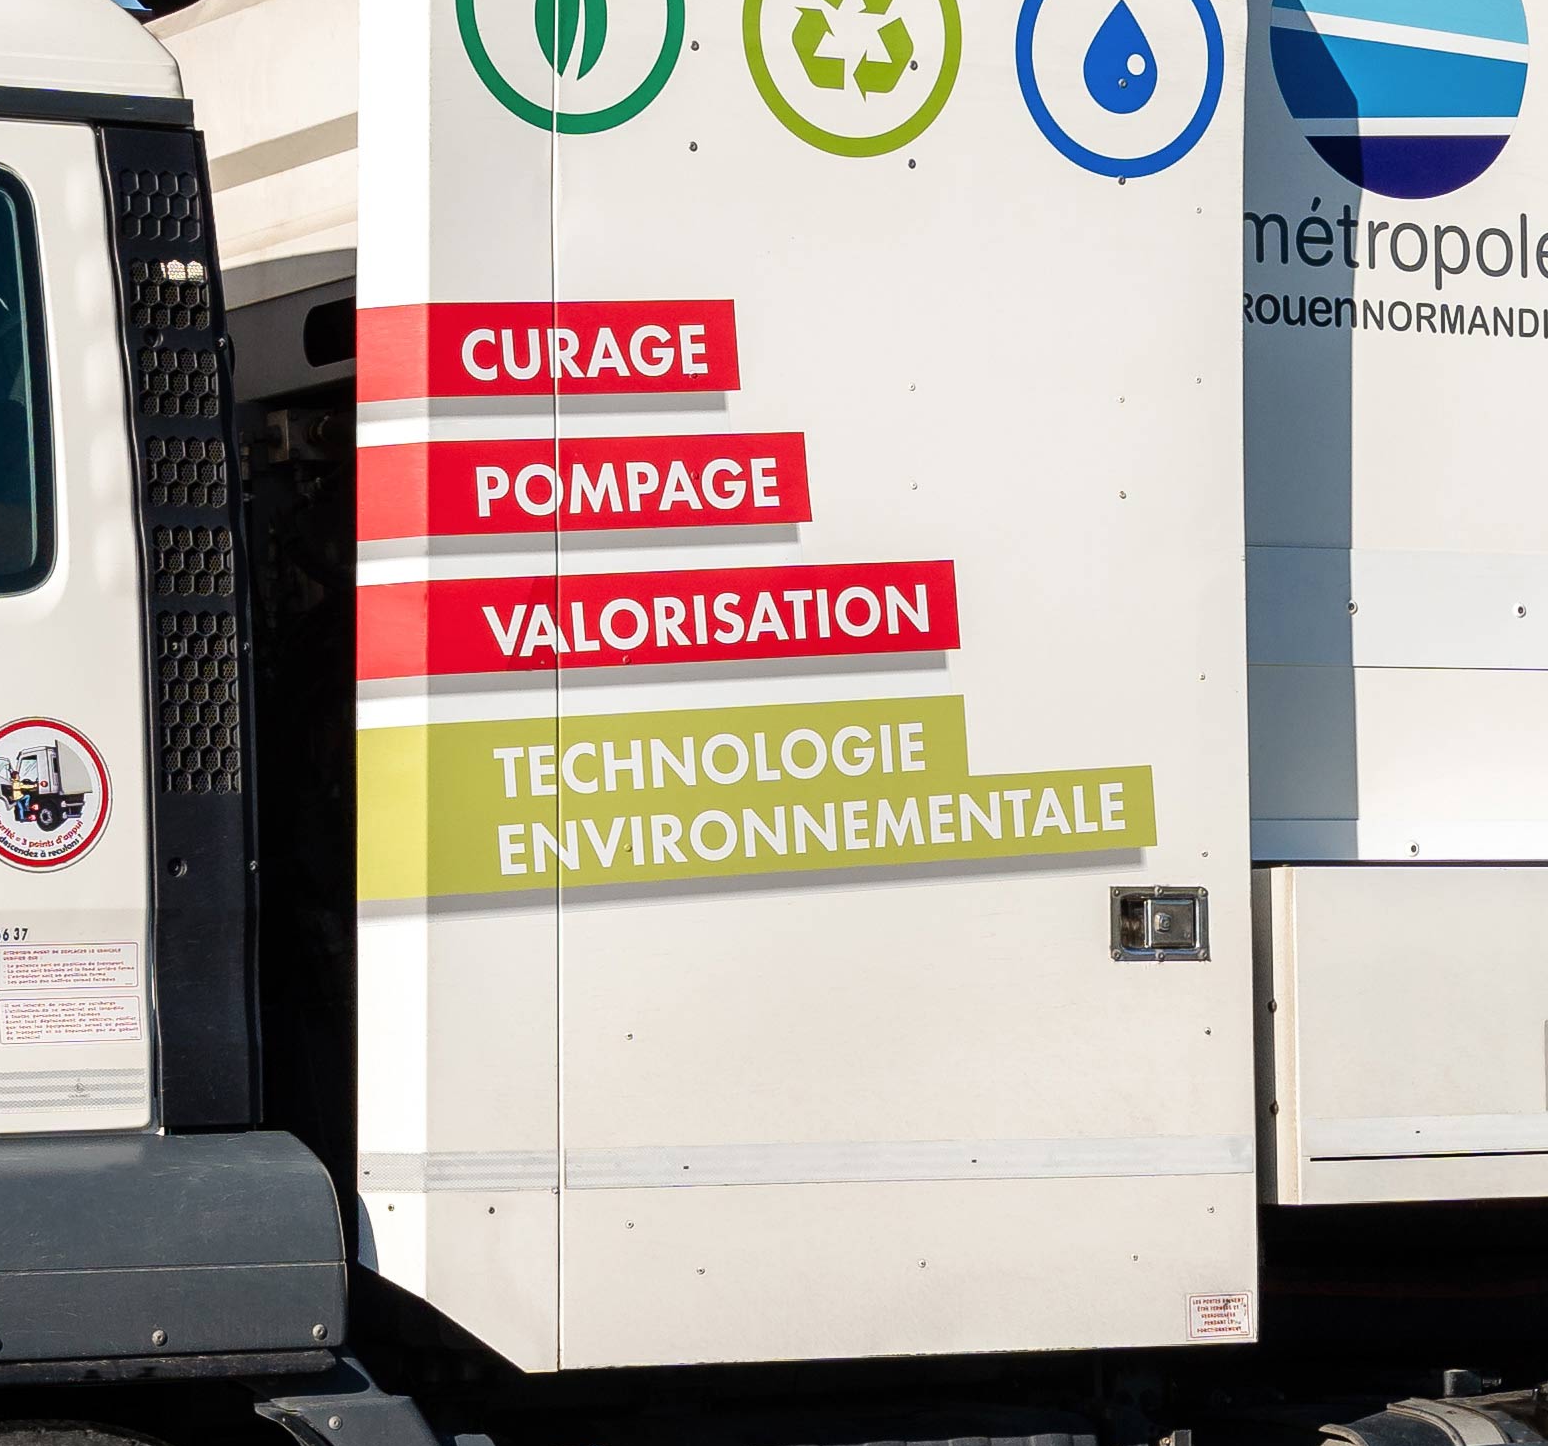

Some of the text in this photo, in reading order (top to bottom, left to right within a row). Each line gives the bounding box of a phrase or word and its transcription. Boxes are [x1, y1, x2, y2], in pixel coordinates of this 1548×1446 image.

[462, 325, 708, 381] CURAGE
[476, 458, 779, 517] POMPAGE
[483, 585, 929, 657] VALORISATION
[494, 723, 925, 799] TECHNOLOGIE
[28, 840, 54, 848] points
[498, 783, 1125, 876] ENVIRONNEMENTALE
